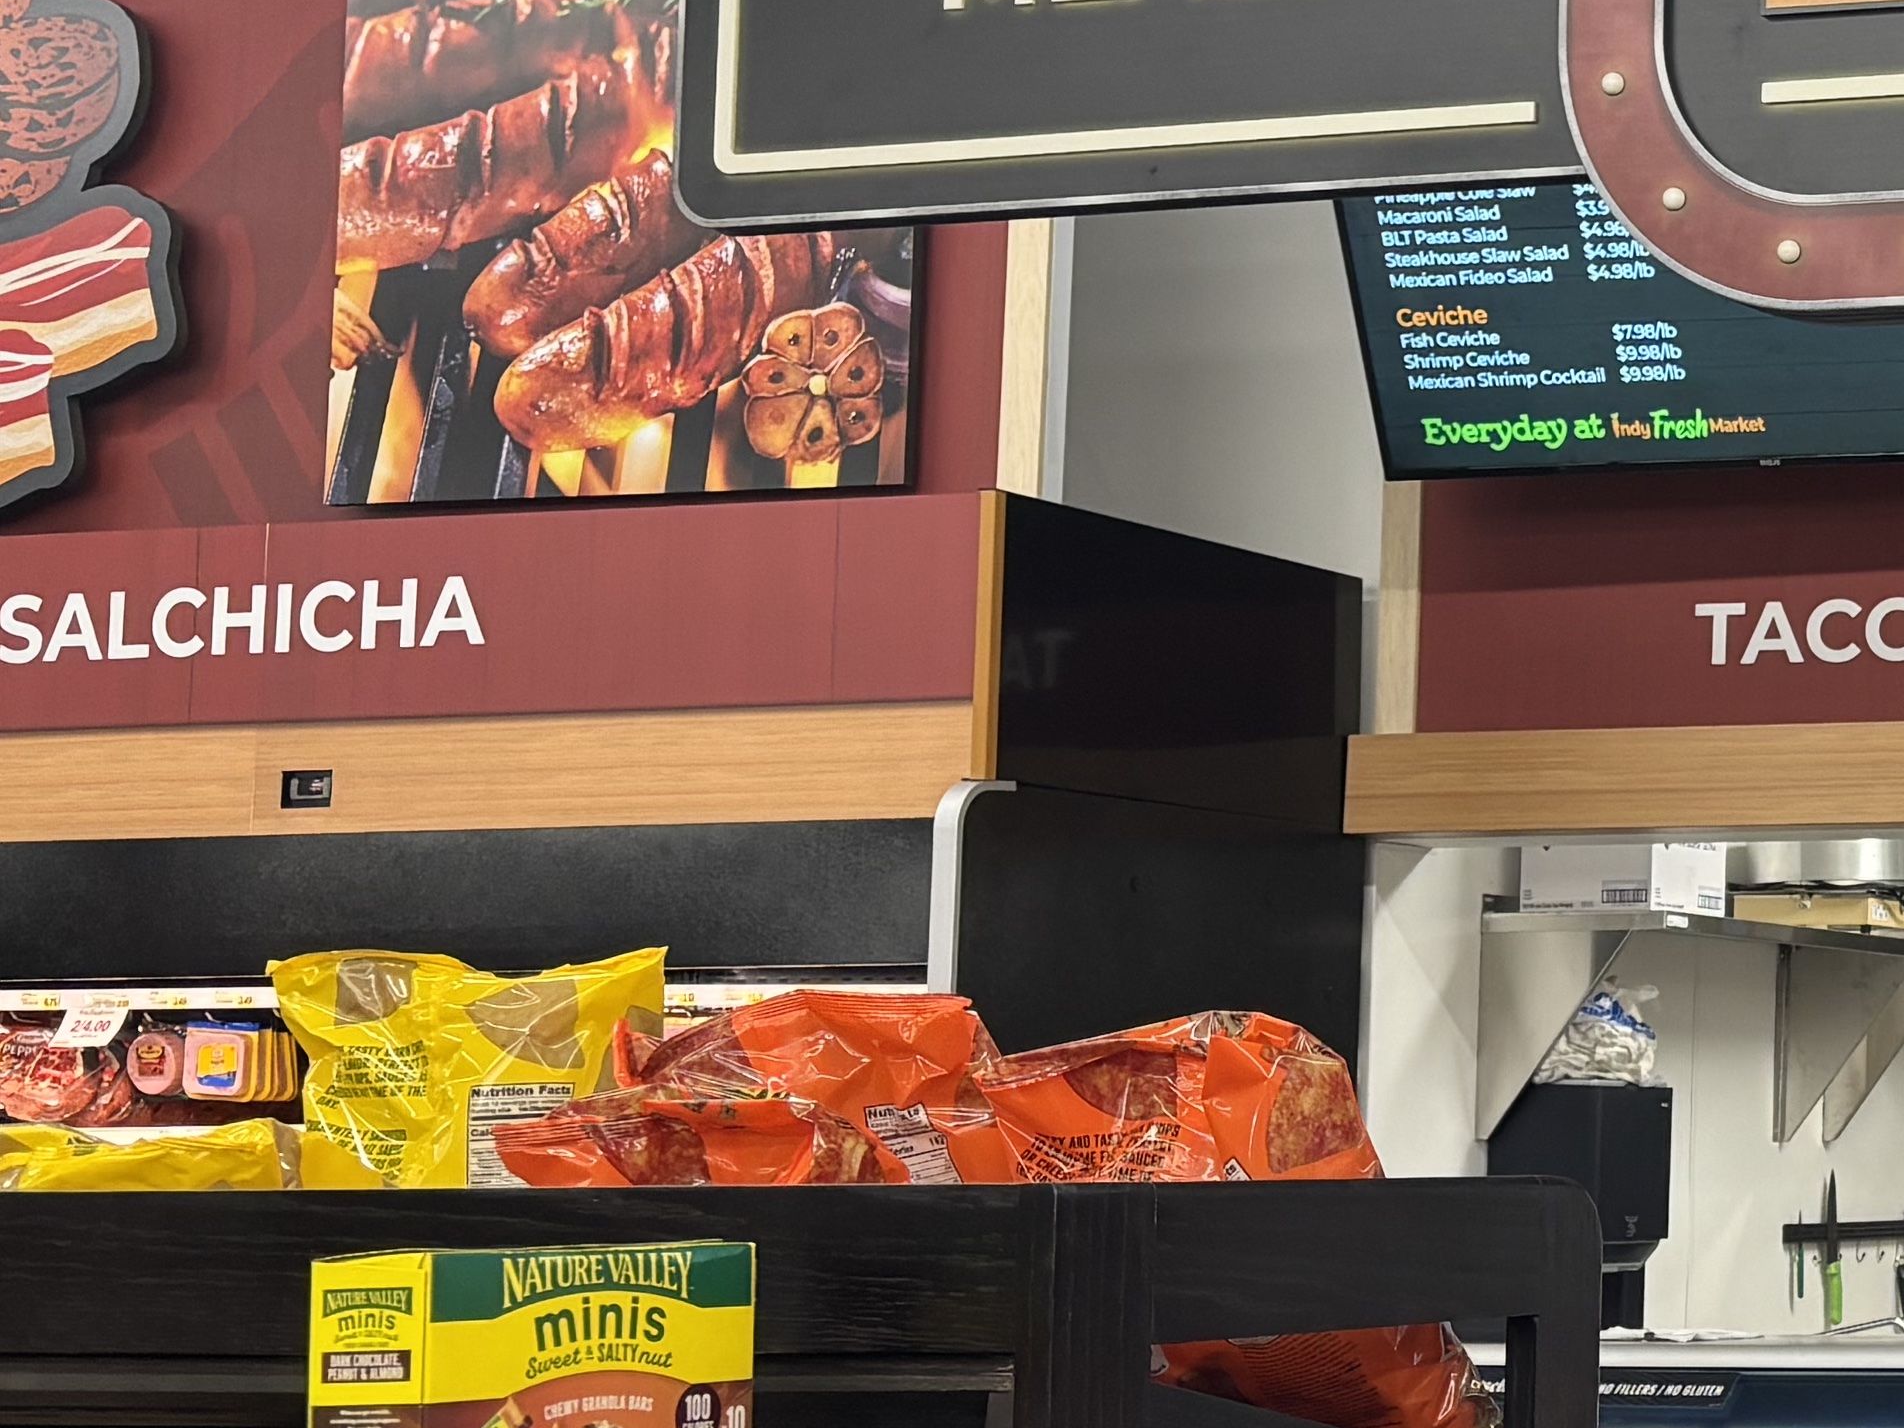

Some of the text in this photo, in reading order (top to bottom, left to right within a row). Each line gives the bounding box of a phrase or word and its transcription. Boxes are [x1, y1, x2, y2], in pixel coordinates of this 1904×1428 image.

[1377, 204, 1500, 225] Macaroni Salad
[1381, 226, 1508, 246] BLT Pasta Salad
[1385, 244, 1569, 267] Steakhouse Slaw Salad
[1389, 261, 1655, 288] Mexican Fideo Salad $4.98/lb
[1396, 306, 1488, 327] Ceviche
[1400, 322, 1677, 348] Fish Ceviche $7.98/lb
[1403, 343, 1682, 371] Shrimp Ceviche $9.98/lb
[1408, 364, 1686, 390] Mexican Shrimp Cocktail $9.98/lb
[1421, 408, 1765, 451] Everyday at Fresh Market
[0, 576, 486, 664] SALCHICHA
[539, 1085, 572, 1096] Facts
[503, 1251, 692, 1308] NATURE VALLEY
[338, 1311, 396, 1333] minis
[534, 1296, 666, 1352] minis
[525, 1344, 672, 1379] Sweet SALTY nut
[1614, 1384, 1724, 1396] FILLERS NO GLUTEN
[684, 1392, 711, 1421] 100
